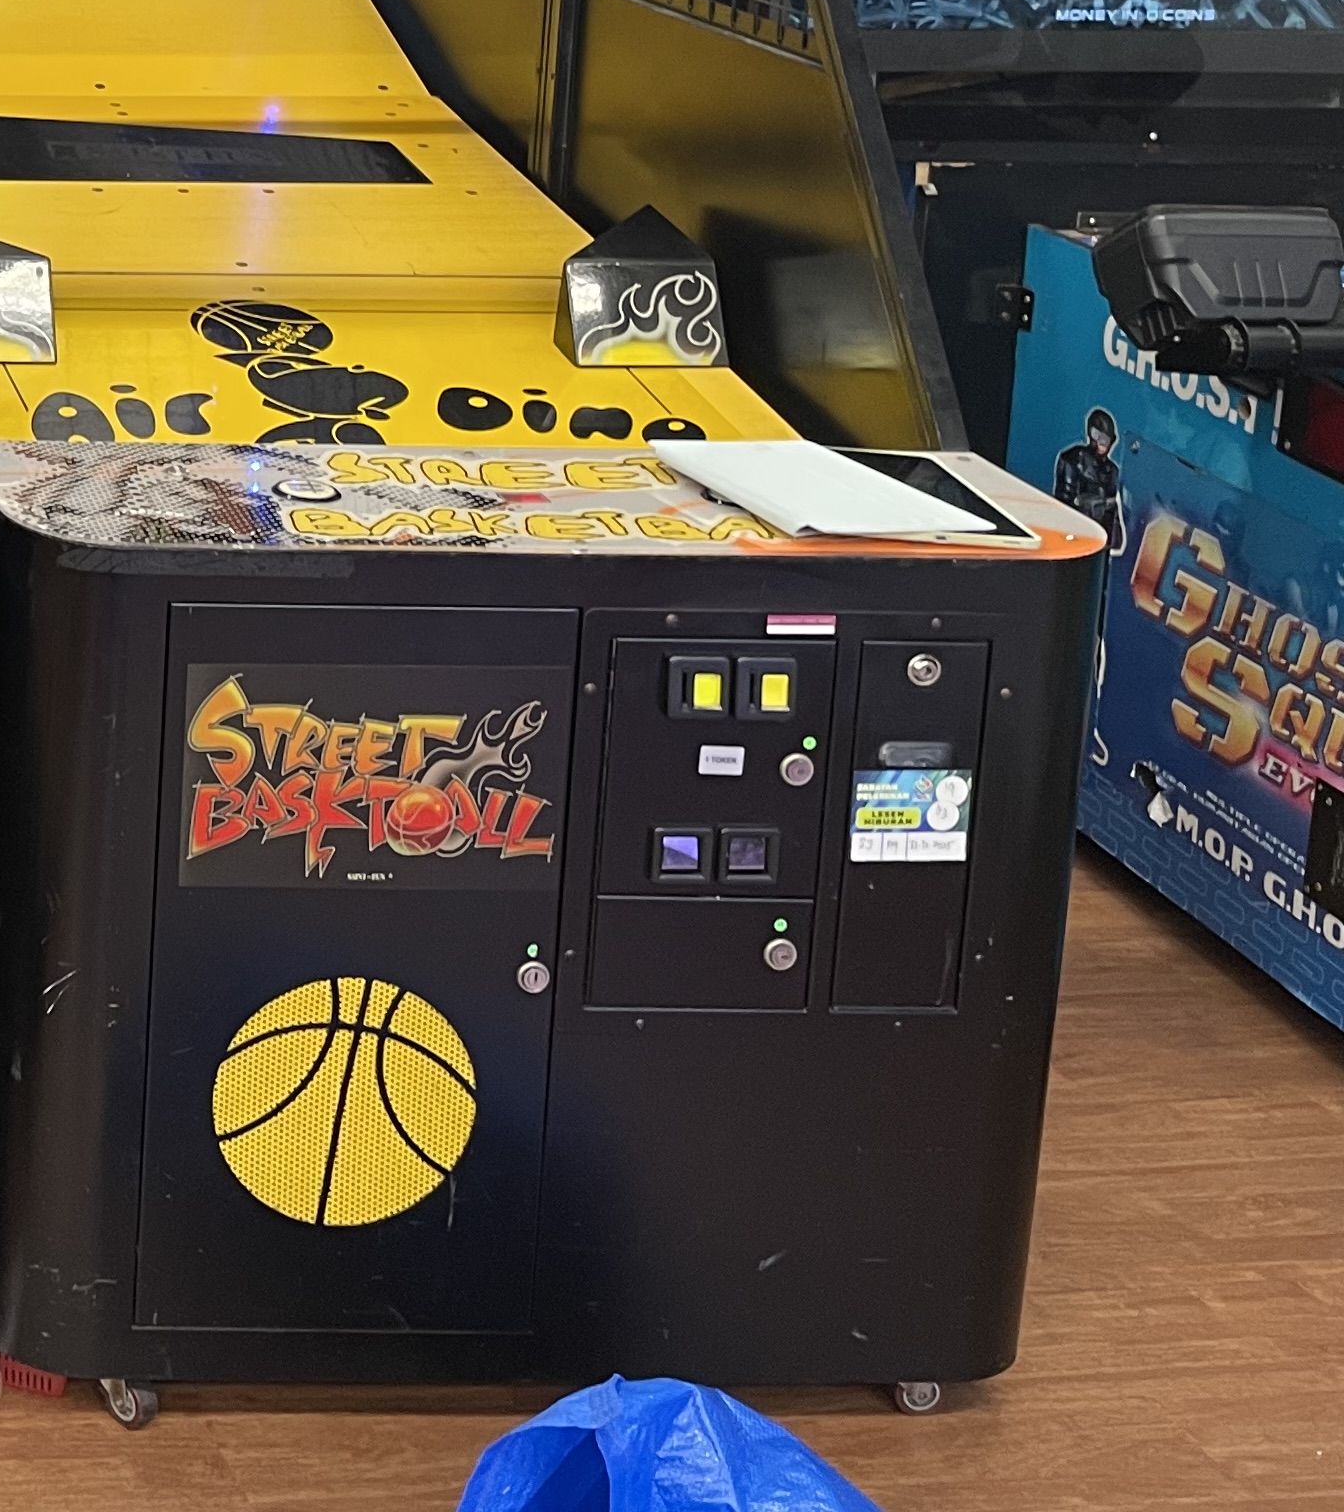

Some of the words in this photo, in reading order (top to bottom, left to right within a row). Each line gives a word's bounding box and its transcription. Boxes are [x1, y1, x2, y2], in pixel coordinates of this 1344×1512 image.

[1055, 9, 1117, 21] MONEY
[1121, 9, 1138, 21] IN
[1162, 9, 1216, 22] COINS
[326, 451, 678, 493] STREET
[288, 508, 782, 543] BASKETBA
[187, 673, 468, 788] STREET
[711, 755, 738, 765] TOKEN
[1259, 753, 1316, 803] EV
[863, 818, 913, 826] HIBURAN
[871, 810, 905, 818] LESEN
